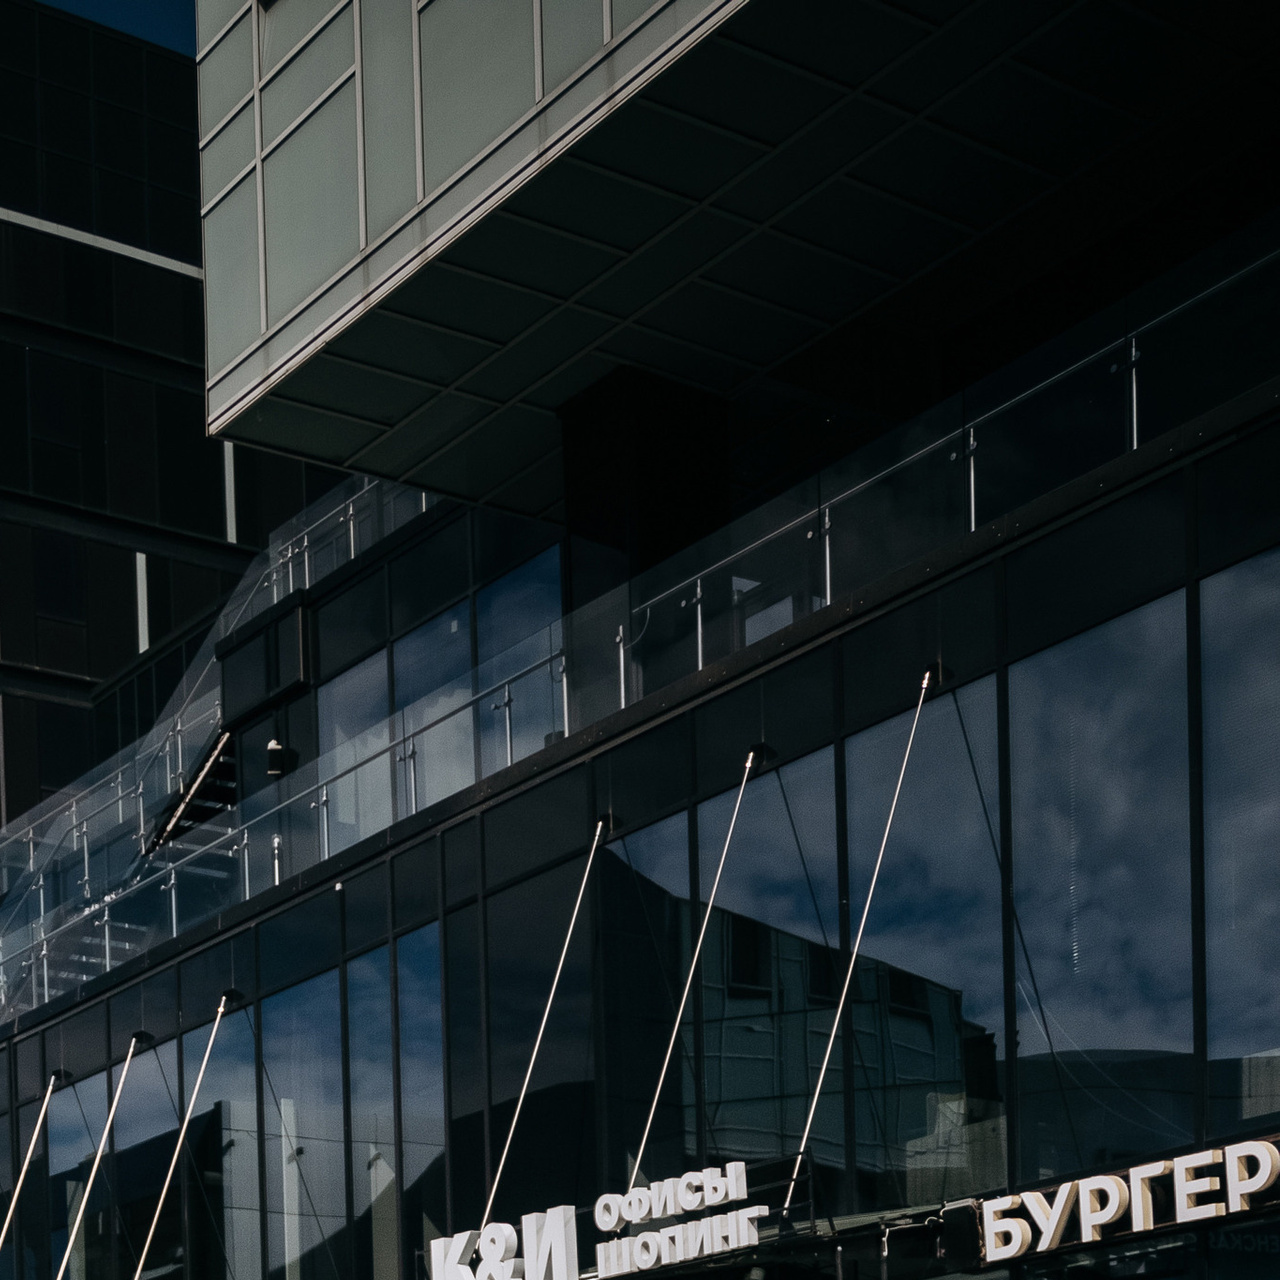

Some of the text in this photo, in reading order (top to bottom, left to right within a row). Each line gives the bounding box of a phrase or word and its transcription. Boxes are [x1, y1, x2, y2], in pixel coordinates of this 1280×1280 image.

[594, 1161, 748, 1232] ОФИСЫ
[982, 1140, 1280, 1262] БУРГЕР
[595, 1205, 769, 1279] ШОПИНГ
